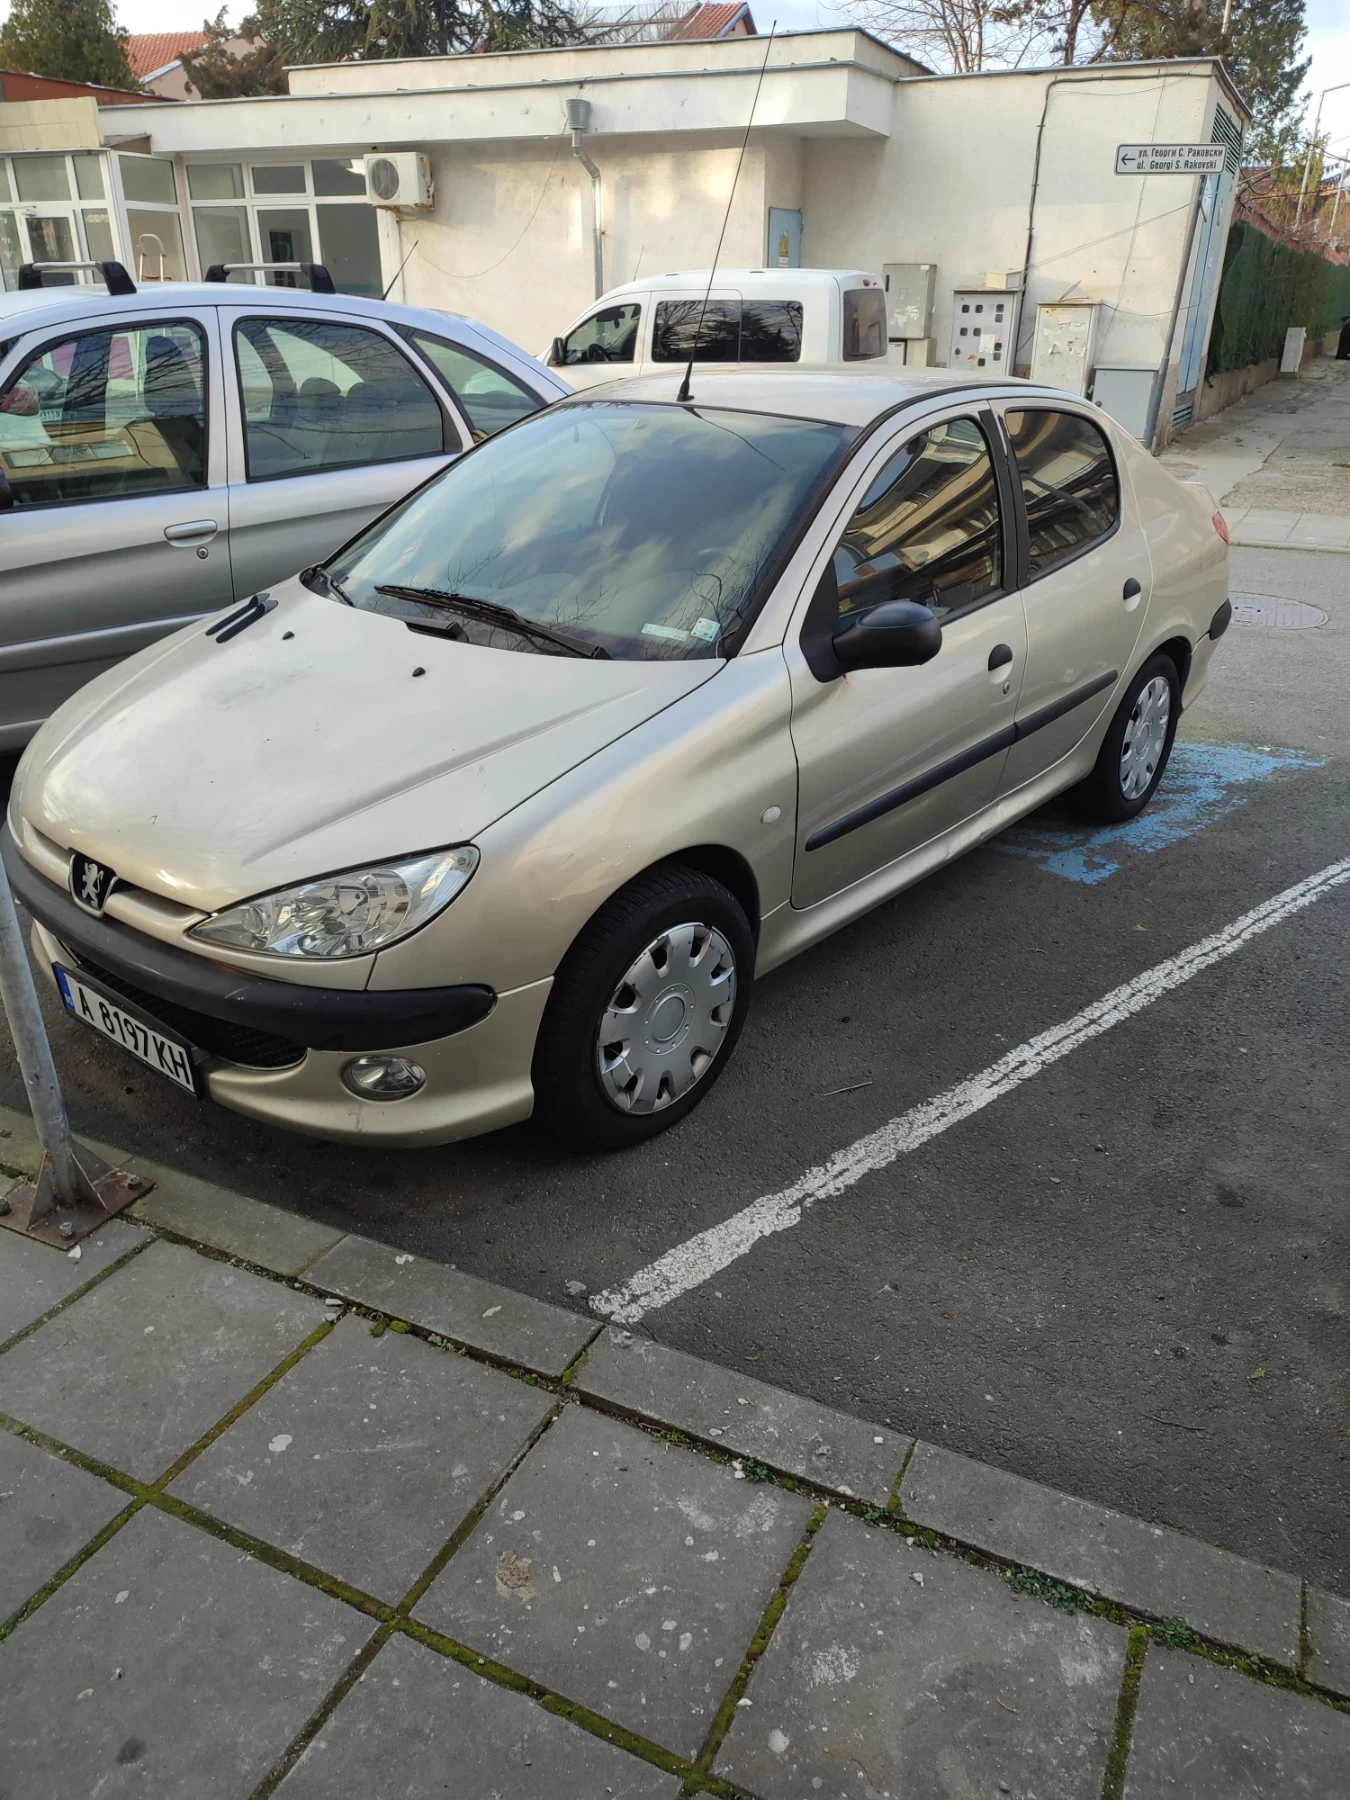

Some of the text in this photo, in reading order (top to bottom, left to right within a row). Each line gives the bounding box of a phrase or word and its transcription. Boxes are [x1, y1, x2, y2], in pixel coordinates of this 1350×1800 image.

[1138, 148, 1223, 159] ул. Георги С. Раковски
[1137, 160, 1217, 170] ul. Georgi S. Rakovski
[78, 986, 95, 1022] A
